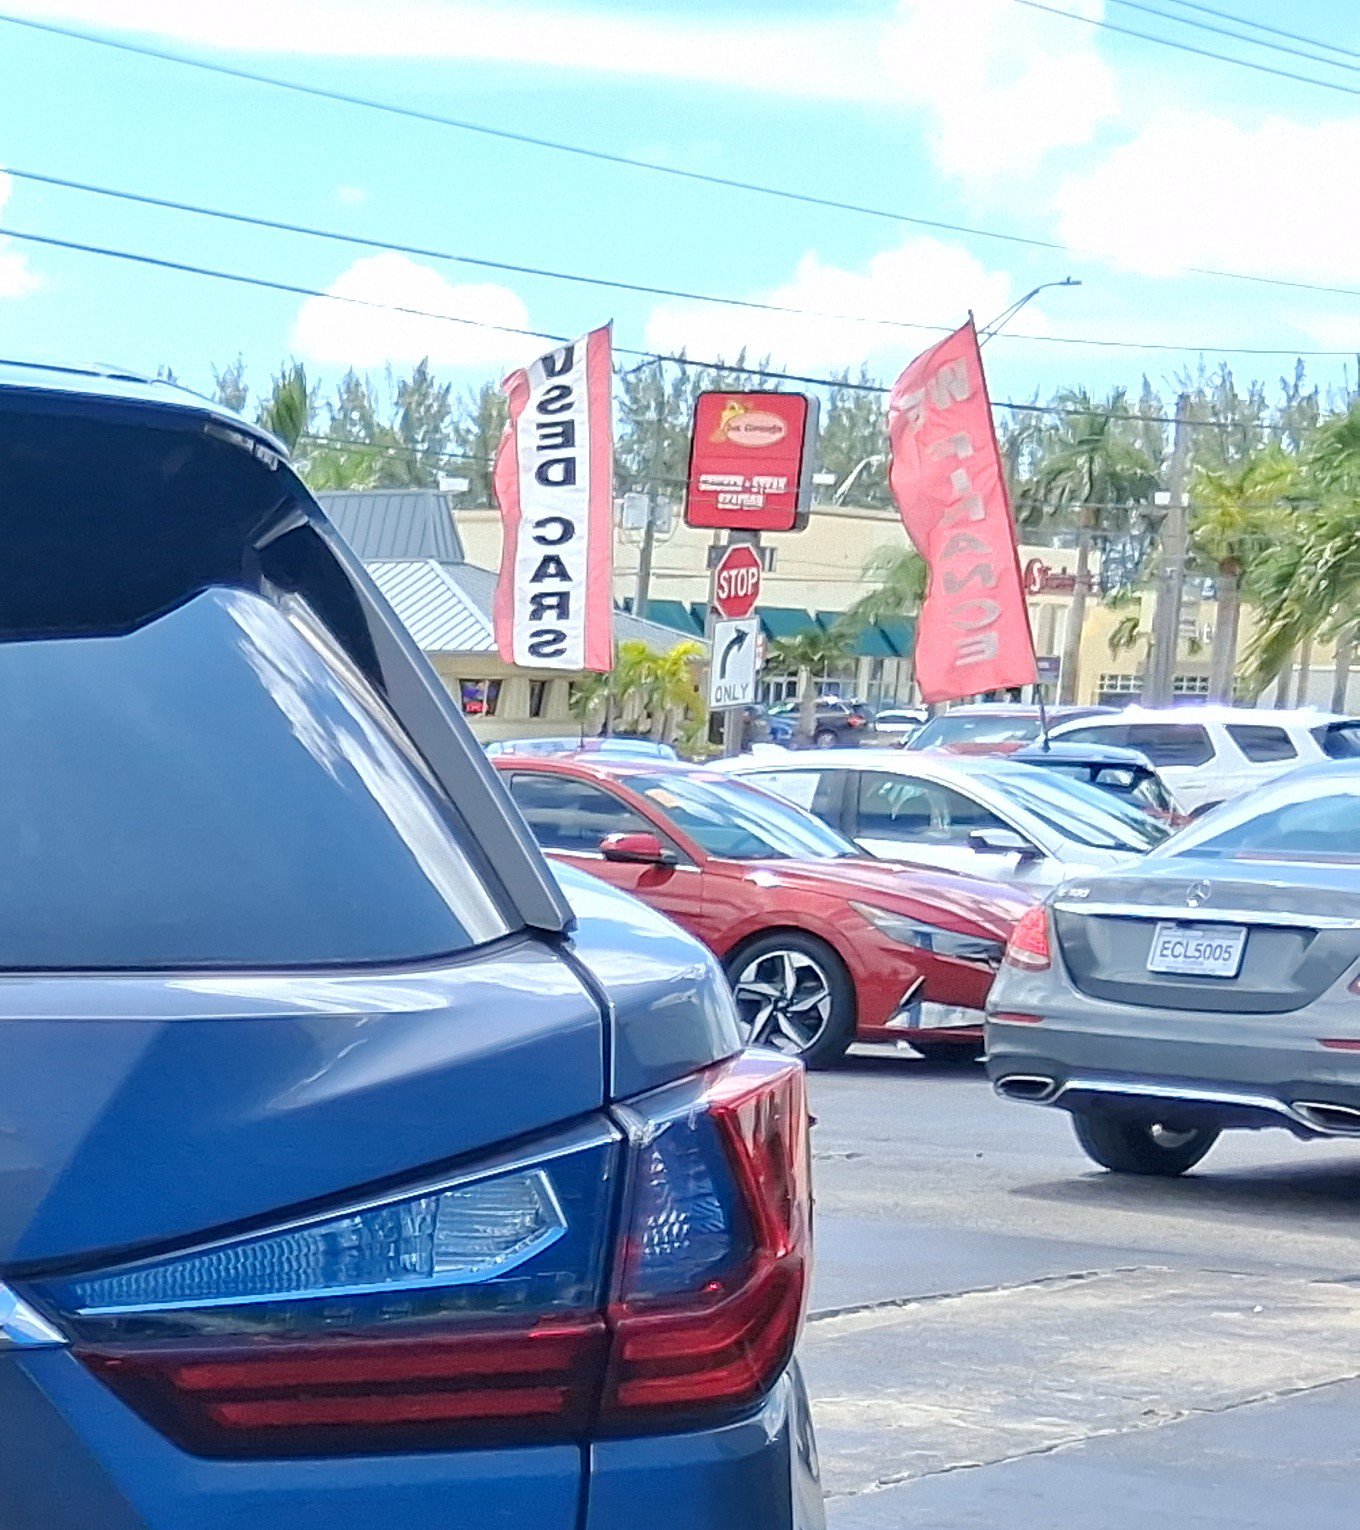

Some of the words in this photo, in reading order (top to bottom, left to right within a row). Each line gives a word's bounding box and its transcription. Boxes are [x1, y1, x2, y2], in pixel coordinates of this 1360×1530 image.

[717, 566, 759, 600] STOP
[714, 682, 750, 703] ONLY
[1158, 939, 1235, 963] ECL5005
